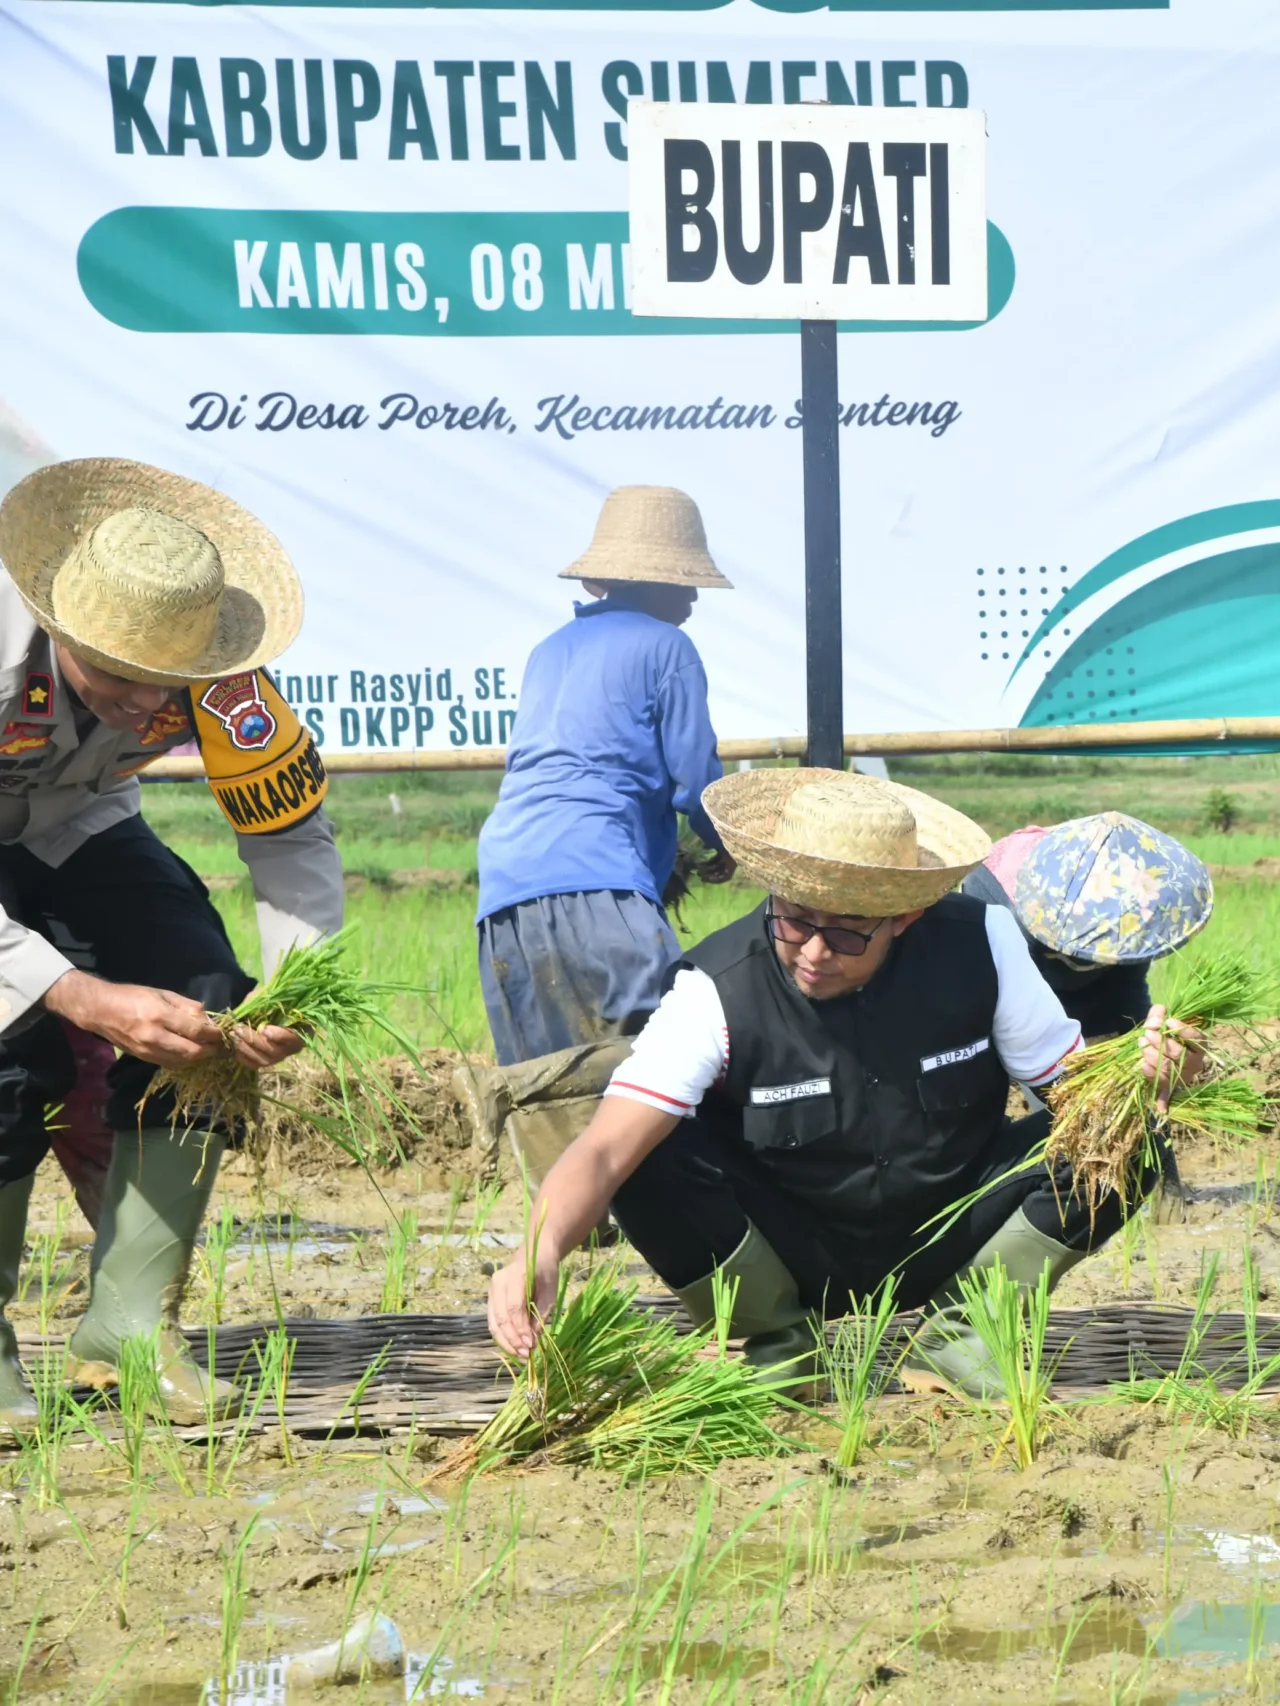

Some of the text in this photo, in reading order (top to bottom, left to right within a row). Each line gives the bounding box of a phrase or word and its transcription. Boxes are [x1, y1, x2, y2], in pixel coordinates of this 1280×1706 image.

[106, 55, 577, 162] KABUPATEN
[663, 138, 951, 286] BUPATI
[233, 239, 449, 323] KAMIS,
[470, 242, 545, 312] 08
[186, 391, 963, 440] Di Desa Poreh, Kecamatan nteng
[350, 667, 464, 706] Rasyid,
[340, 706, 434, 747] DKPP
[936, 1044, 977, 1066] BUPATI
[764, 1090, 787, 1103] ACH
